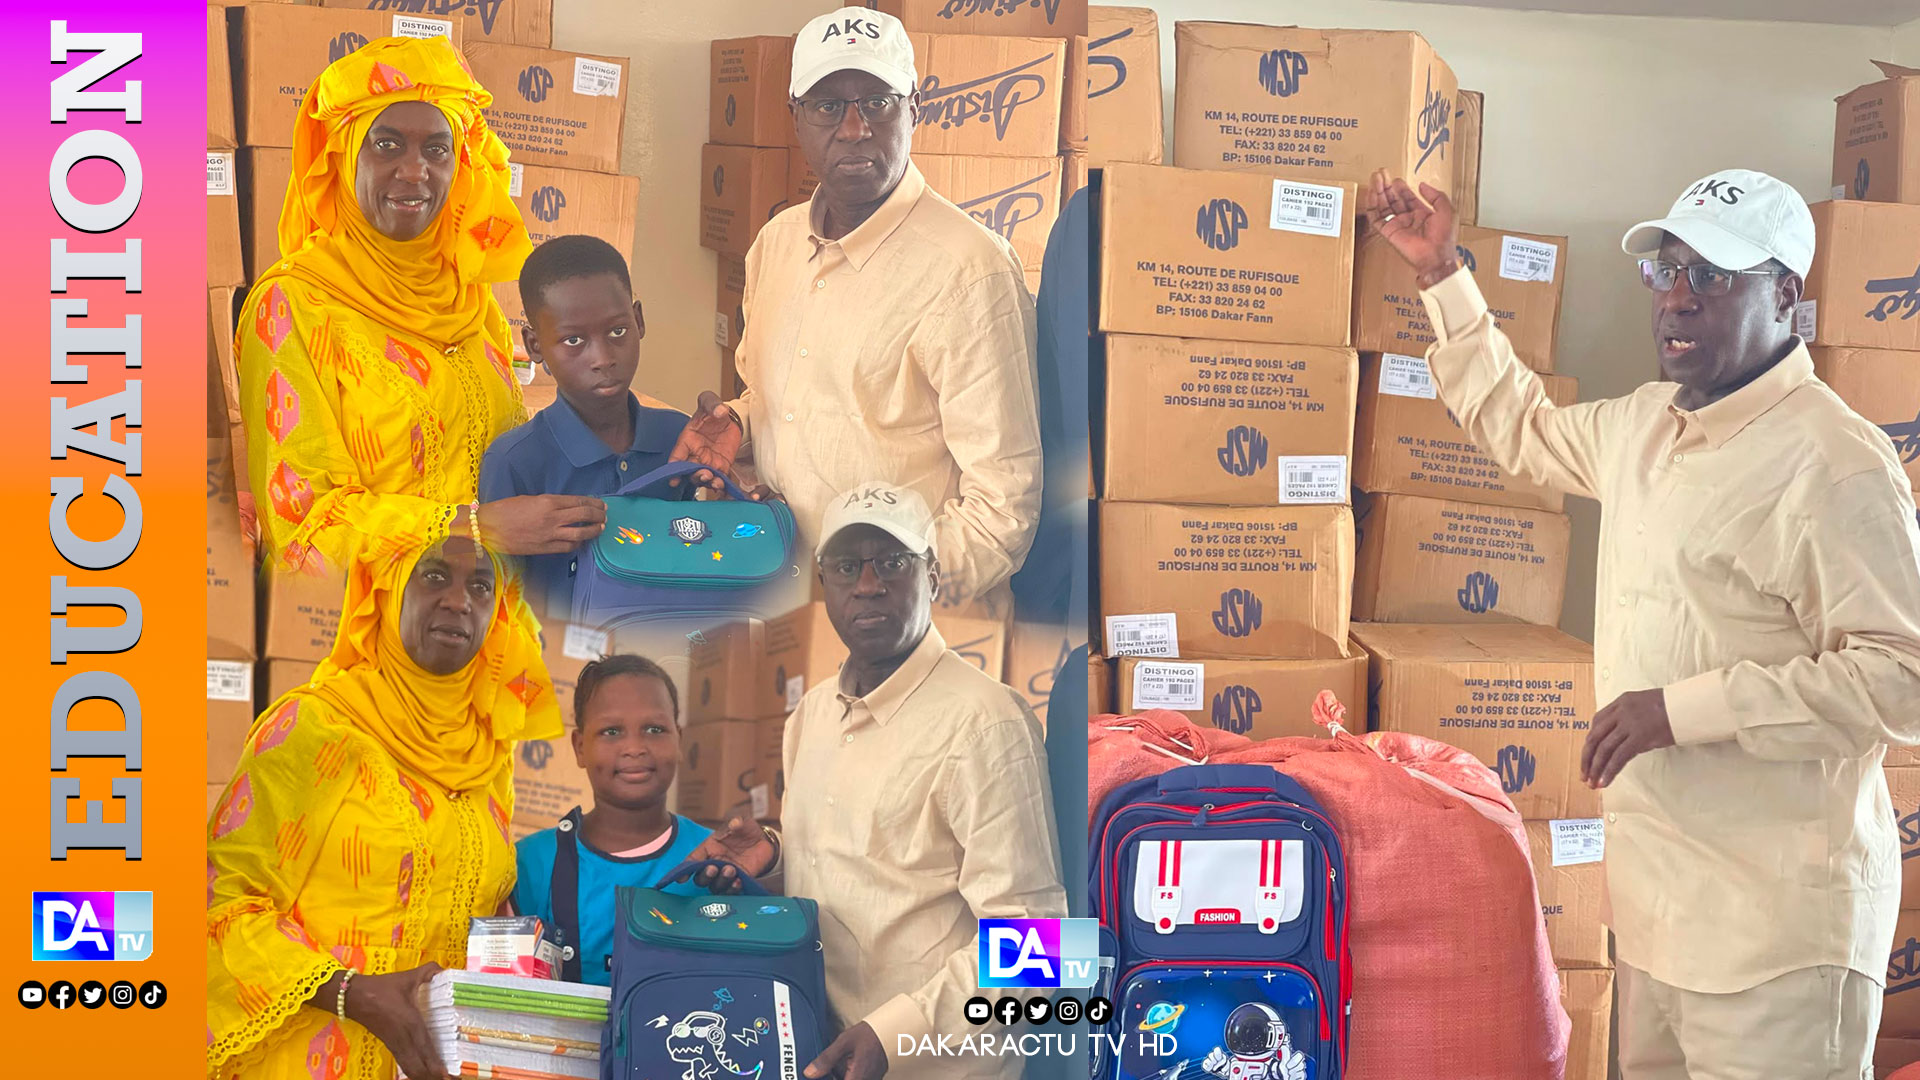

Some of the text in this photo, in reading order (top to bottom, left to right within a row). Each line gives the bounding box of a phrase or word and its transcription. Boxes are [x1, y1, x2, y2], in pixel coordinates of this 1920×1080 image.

[402, 22, 444, 32] DISTINGO
[821, 18, 881, 43] AKS
[582, 65, 616, 75] DISTINGO
[1259, 49, 1308, 97] MSP
[518, 65, 554, 103] MSP
[503, 111, 531, 121] ROUTE
[532, 115, 544, 123] DE
[545, 117, 587, 128] RUFISQUE
[1205, 110, 1358, 128] KM 14, ROUTE DE RUFISQUE
[1220, 125, 1343, 140] TEL: (+221) 33 859 04 00
[1234, 139, 1326, 153] FAX: 33 820 24 62
[1223, 152, 1334, 167] BP: 15106 Dakar Fann
[1284, 188, 1333, 200] DISTINGO
[1682, 180, 1745, 204] AKS
[531, 186, 566, 223] MSP
[1196, 199, 1248, 251] MSP
[1511, 244, 1551, 257] DISTINGO
[1137, 261, 1300, 284] KM 14, ROUTE DE RUFISQUE
[1153, 276, 1283, 296] TEL: (+221) 33 859 04 00
[1169, 292, 1266, 309] FAX: 33 820 24 62
[1156, 305, 1273, 323] BP: 15106 Dakar Fann
[1190, 355, 1306, 370] BP: 15106 Dakar Fann
[1199, 369, 1294, 383] FAX: 33 820 24 62
[1181, 382, 1310, 397] TEL: (+221) 33 859 04 00
[1164, 395, 1325, 411] KM 14, ROUTE DE RUFISQUE
[1218, 425, 1268, 477] MSP
[843, 487, 898, 509] AKS
[1288, 490, 1336, 498] DISTINGO
[1182, 520, 1298, 531] BP: 15106 Dakar Fann
[1191, 534, 1286, 544] FAX: 33 820 24 62
[1174, 548, 1303, 558] TEL: (+221) 33 859 04 00
[1158, 561, 1317, 571] KM 14, ROUTE DE RUFISQUE
[1458, 571, 1499, 613] MSP
[1212, 588, 1262, 637] MSP
[1117, 647, 1167, 656] DISTINGO
[1144, 667, 1194, 676] DISTINGO
[1464, 679, 1573, 689] BP: 15106 Dakar Fann
[1472, 692, 1562, 702] FAX: 33 820 24 62
[1212, 685, 1262, 735] MSP
[1456, 705, 1576, 716] TEL: (+221) 33 859 04 00
[1440, 718, 1590, 729] KM 14, ROUTE DE RUFISQUE
[1560, 823, 1603, 832] DISTINGO
[1200, 913, 1236, 922] FASHION
